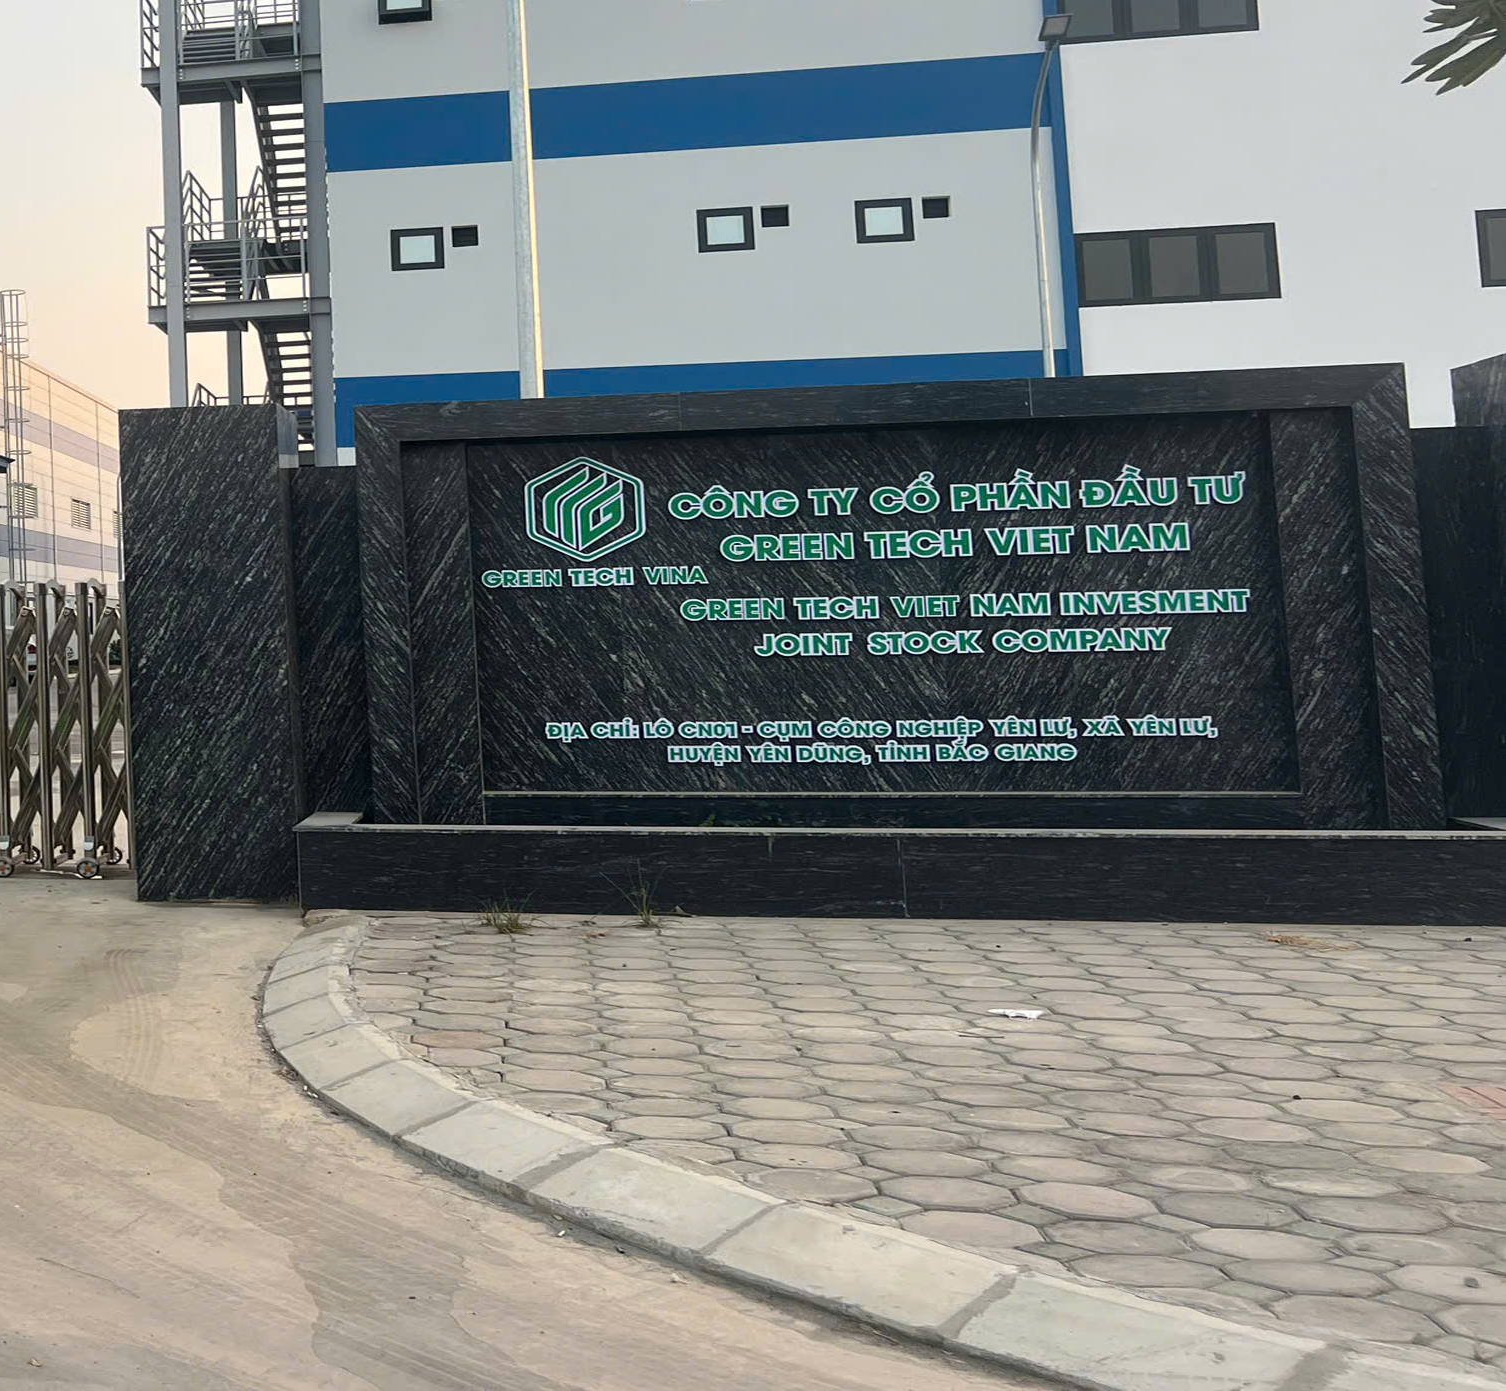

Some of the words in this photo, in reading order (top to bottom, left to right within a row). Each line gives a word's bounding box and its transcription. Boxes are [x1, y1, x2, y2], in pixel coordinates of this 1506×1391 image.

[668, 485, 799, 519] CÔNG
[808, 487, 858, 516] TY
[870, 471, 940, 514] CỔ
[950, 468, 1070, 511] PHẦN
[1079, 464, 1178, 507] ĐẦU
[1188, 471, 1246, 505] TƯ
[720, 533, 855, 561] GREEN
[864, 529, 973, 559] TECH
[985, 526, 1074, 555] VIET
[1086, 523, 1190, 553] NAM
[483, 569, 562, 588] GREEN
[568, 567, 634, 586] TECH
[642, 566, 708, 585] VINA
[680, 598, 785, 621] GREEN
[794, 596, 881, 620] TECH
[891, 595, 960, 618] VIET
[970, 593, 1051, 616] NAM
[1060, 589, 1250, 615] INVESMENT
[754, 633, 853, 656] JOINT
[868, 630, 984, 654] STOCK
[992, 627, 1172, 653] COMPANY
[545, 722, 589, 743] ĐỊA
[643, 718, 674, 738] LÔ
[678, 722, 738, 738] CN01
[757, 721, 812, 742] CỤM
[817, 717, 892, 738] CÔNG
[896, 716, 984, 740] NGHIỆP
[988, 715, 1037, 737] YÊN
[1040, 717, 1077, 739] LƯ,
[1082, 715, 1125, 736] XÃ
[1126, 714, 1176, 736] YÊN
[1179, 716, 1218, 738] LƯ,
[667, 741, 741, 766] HUYỆN
[745, 742, 792, 762] YÊN
[796, 742, 871, 765] DŨNG,
[936, 737, 989, 762] BẮC
[994, 743, 1077, 761] GIANG
